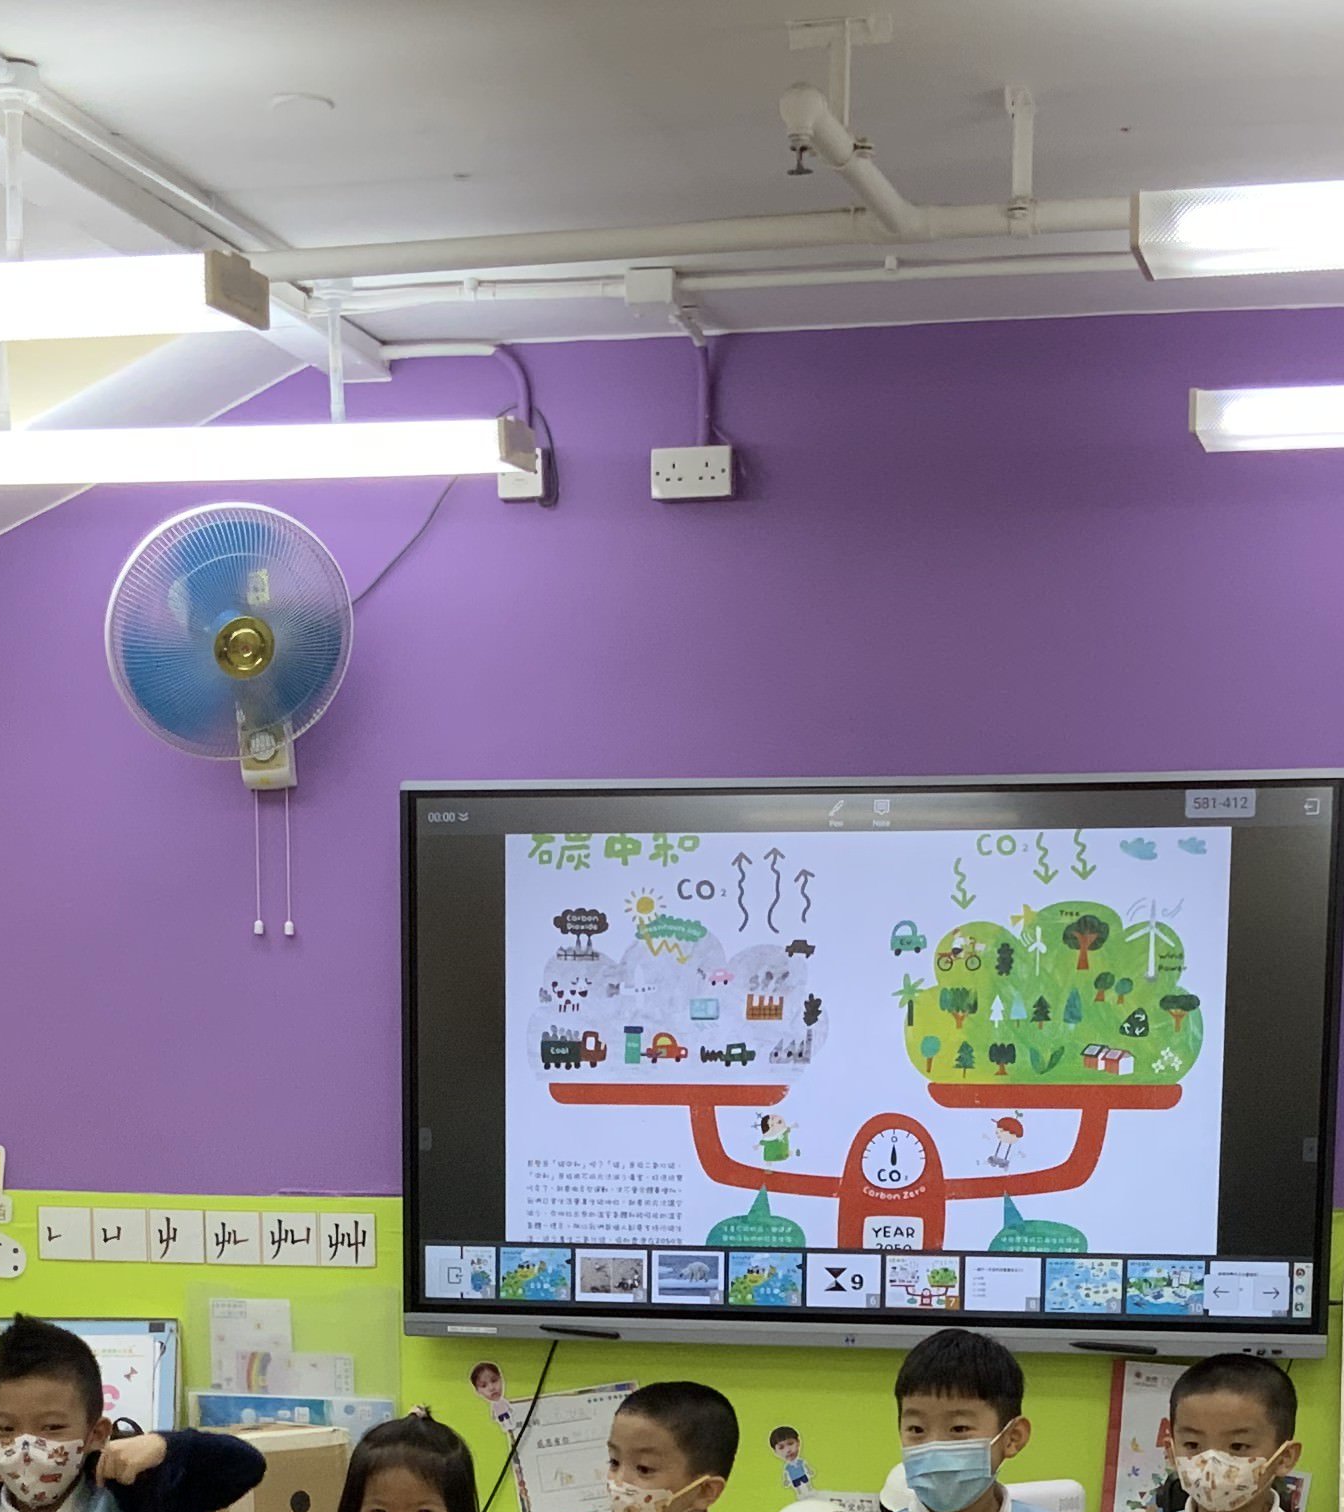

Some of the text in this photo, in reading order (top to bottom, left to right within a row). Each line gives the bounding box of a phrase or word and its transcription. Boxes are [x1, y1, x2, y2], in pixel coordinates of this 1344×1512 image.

[1191, 797, 1249, 810] 581-412
[427, 811, 456, 824] 00:00
[566, 914, 599, 923] Carbon
[550, 1046, 569, 1055] Coal
[863, 1186, 926, 1200] Carbon Zero
[872, 1225, 916, 1239] YEAR
[850, 1272, 864, 1291] 9
[949, 1297, 956, 1307] 7
